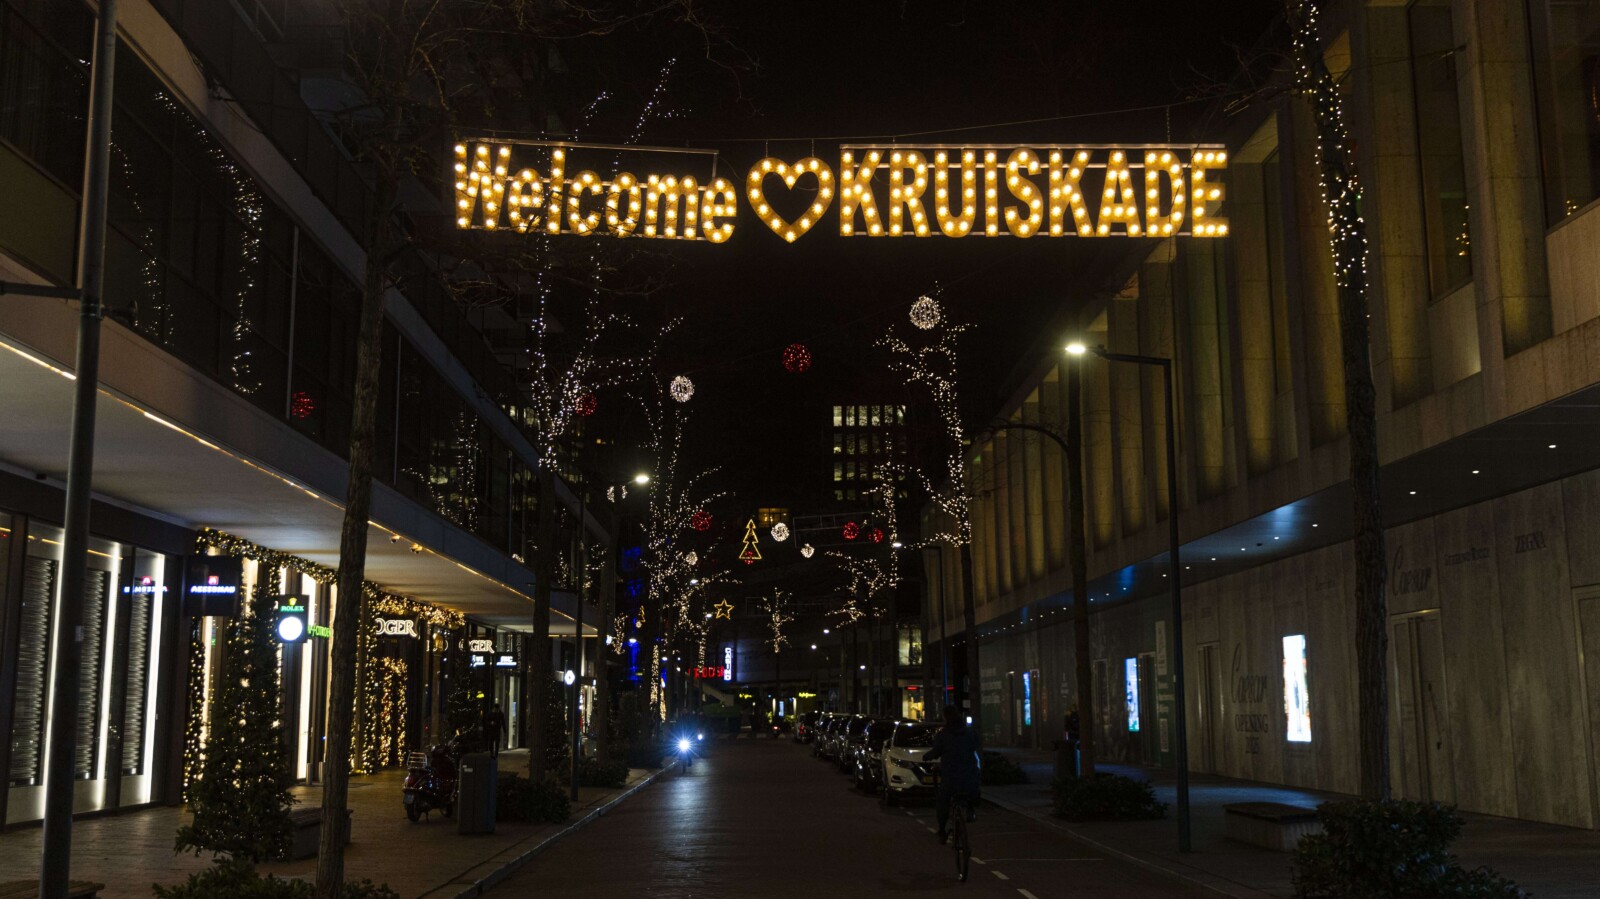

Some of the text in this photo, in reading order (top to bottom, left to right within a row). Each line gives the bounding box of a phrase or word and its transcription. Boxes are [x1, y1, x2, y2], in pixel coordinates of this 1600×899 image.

[454, 142, 1229, 243] Welcome KRUISKADE
[1234, 714, 1269, 733] OPENING
